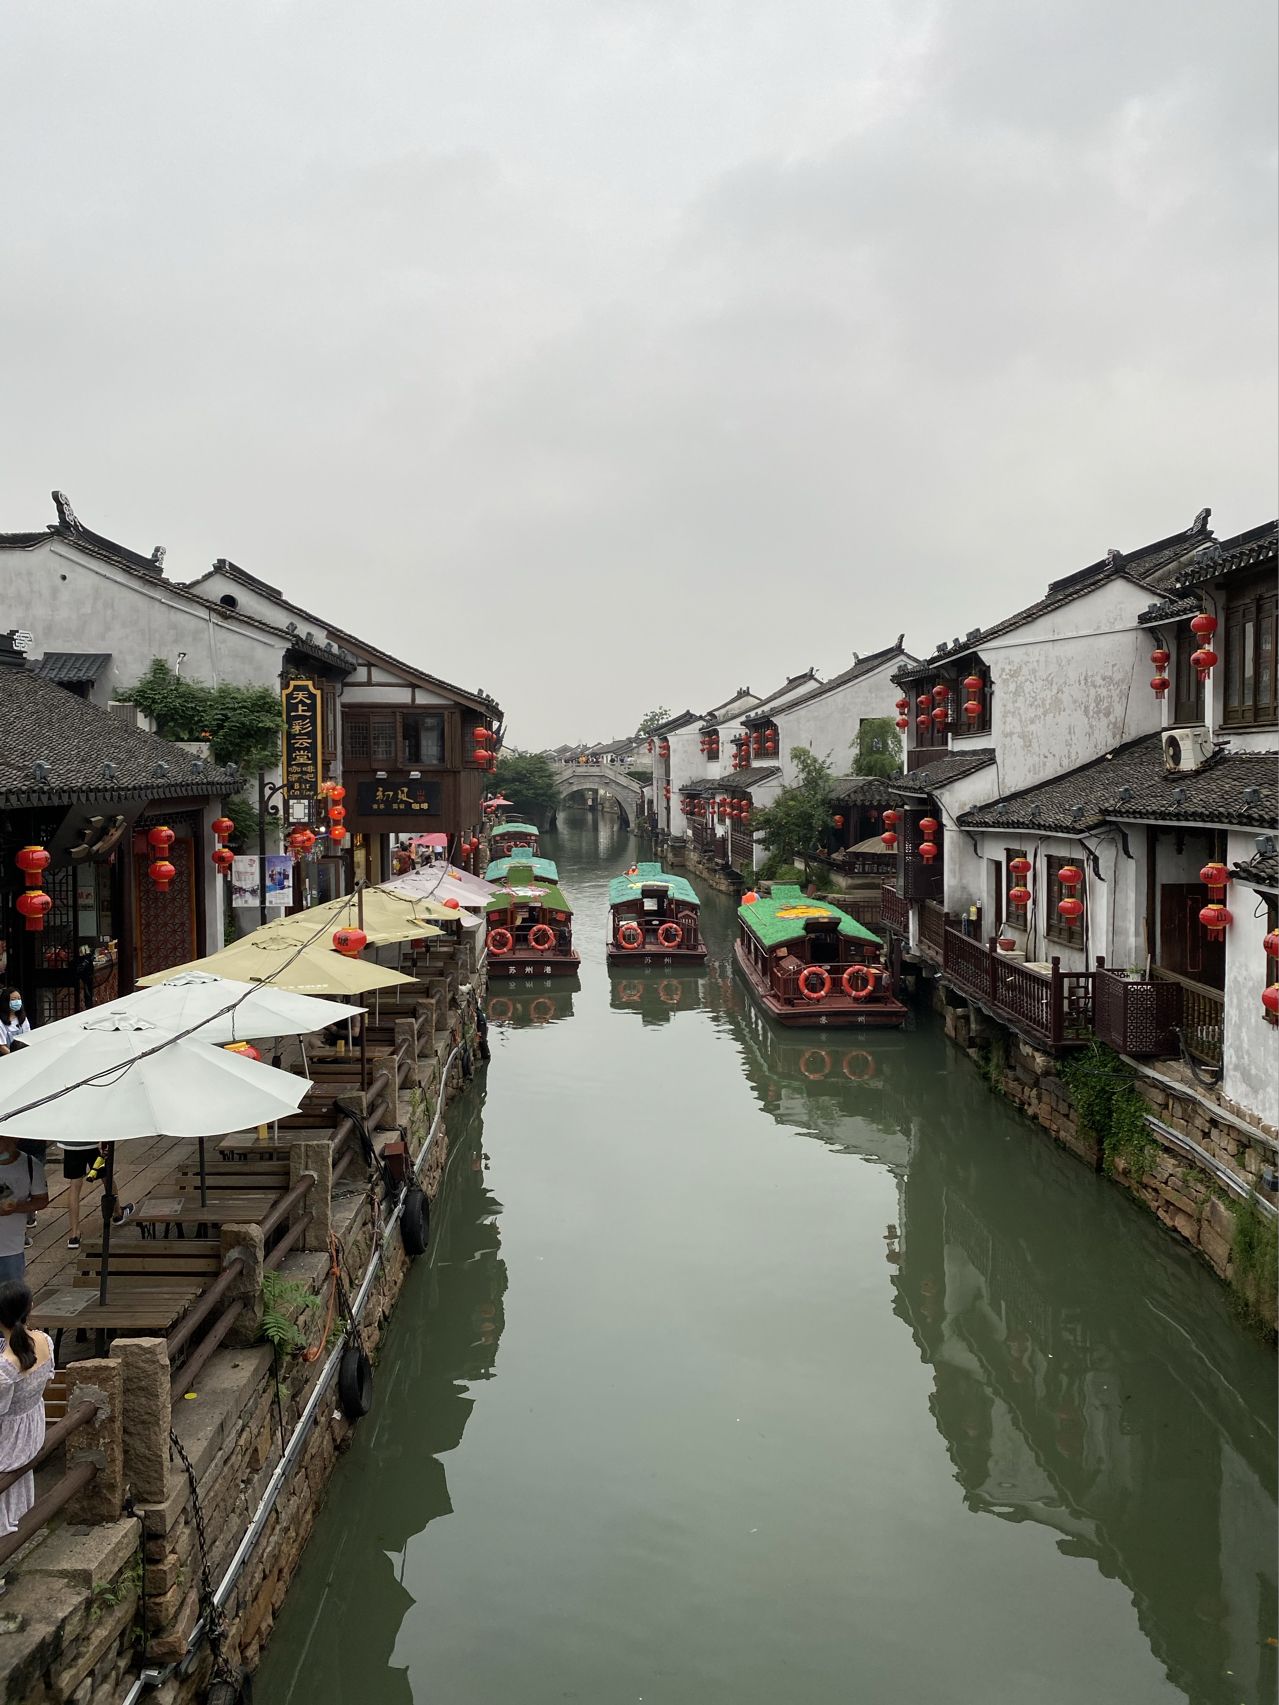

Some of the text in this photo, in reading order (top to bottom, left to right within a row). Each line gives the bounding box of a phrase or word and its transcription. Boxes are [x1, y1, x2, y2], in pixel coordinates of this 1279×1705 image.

[290, 691, 313, 764] 天上彩云堂
[508, 965, 553, 975] 苏州港
